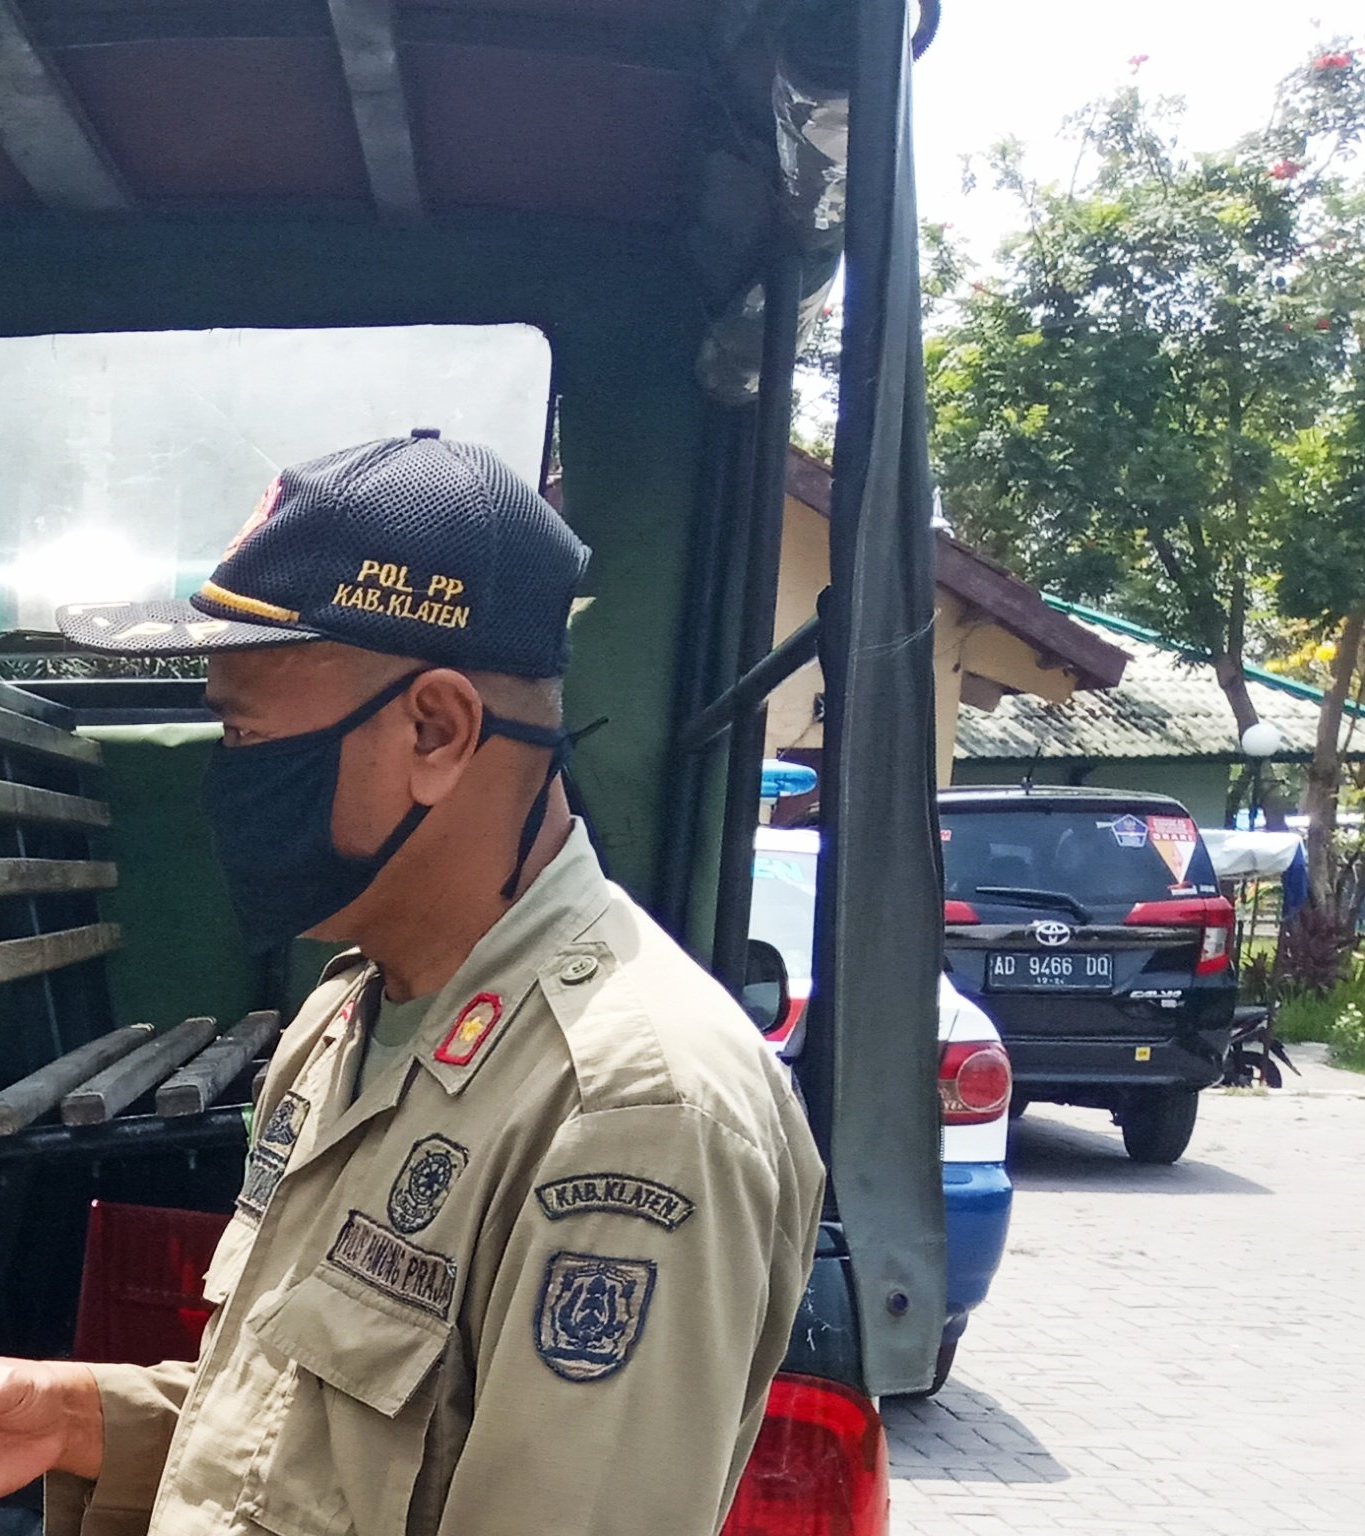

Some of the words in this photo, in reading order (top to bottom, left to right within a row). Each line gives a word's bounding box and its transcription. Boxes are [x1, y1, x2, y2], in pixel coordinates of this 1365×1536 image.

[357, 559, 414, 593] POL
[427, 574, 465, 601] PP
[994, 956, 1015, 975] AD
[1029, 957, 1073, 975] 9466
